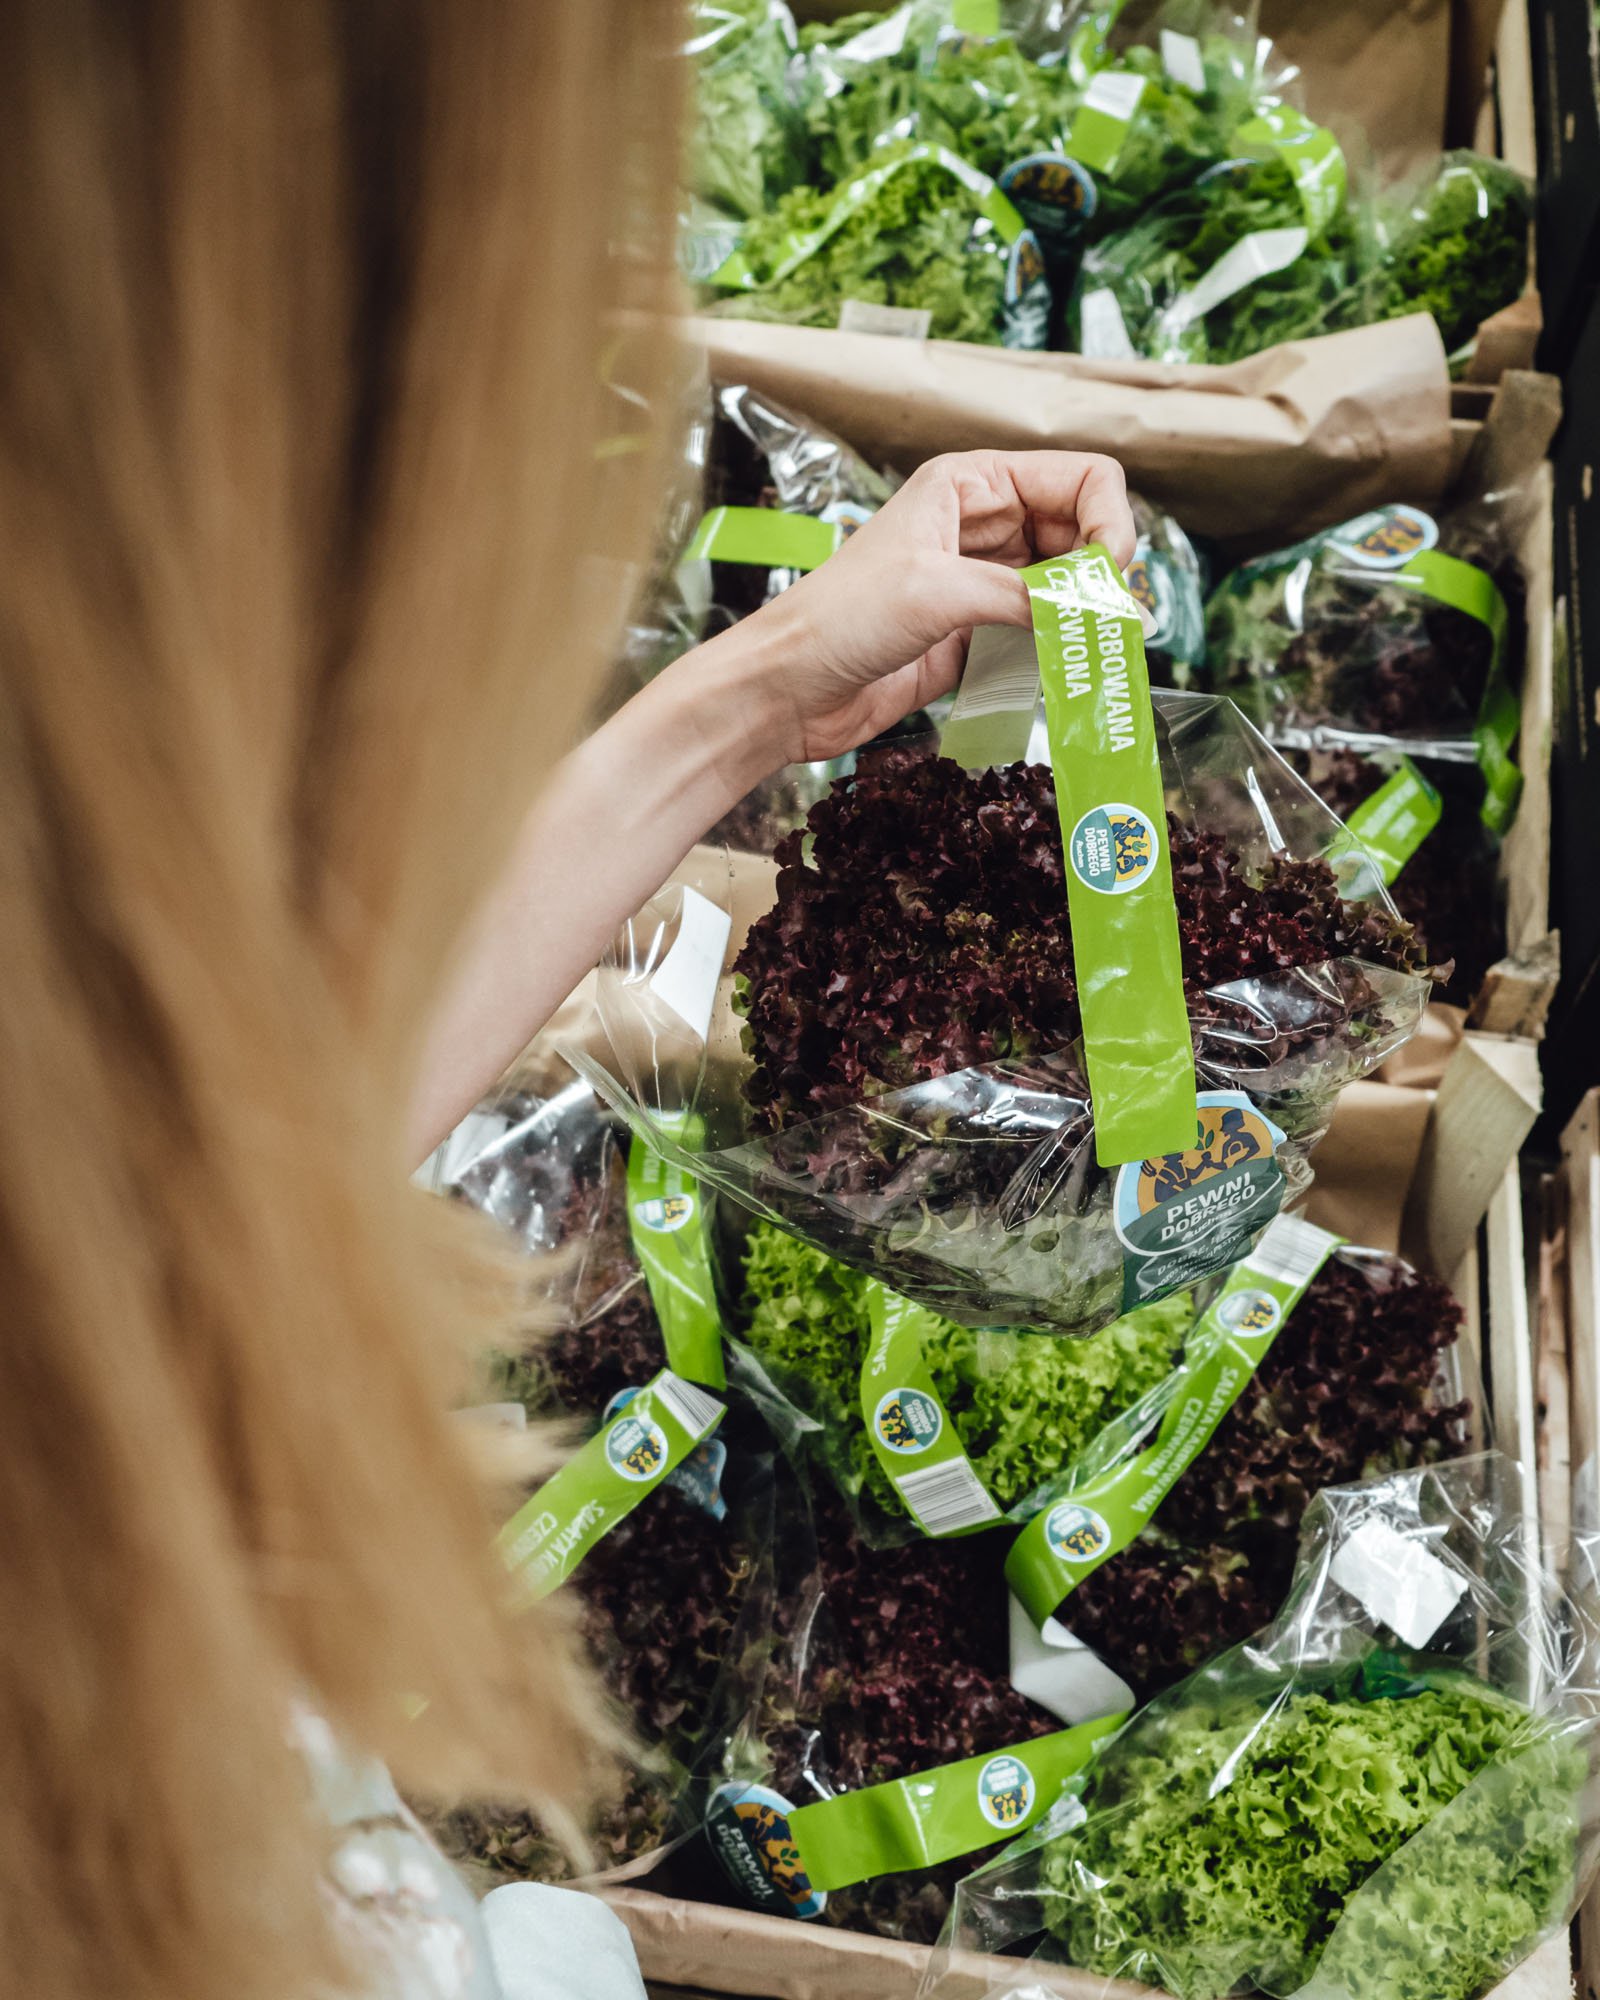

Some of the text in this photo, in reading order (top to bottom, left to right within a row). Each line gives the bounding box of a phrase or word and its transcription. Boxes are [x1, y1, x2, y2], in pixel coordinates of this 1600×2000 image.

[1045, 566, 1092, 699] CZRWONA
[1094, 598, 1136, 753] ARBOWANA
[1084, 826, 1100, 877] DOBREGO
[1096, 828, 1111, 872] PEWNI
[1161, 1184, 1256, 1241] DOBREGO
[1167, 1172, 1251, 1223] PEWNI
[1141, 1397, 1204, 1477] CZERWONA
[730, 1827, 774, 1895] PEWNI
